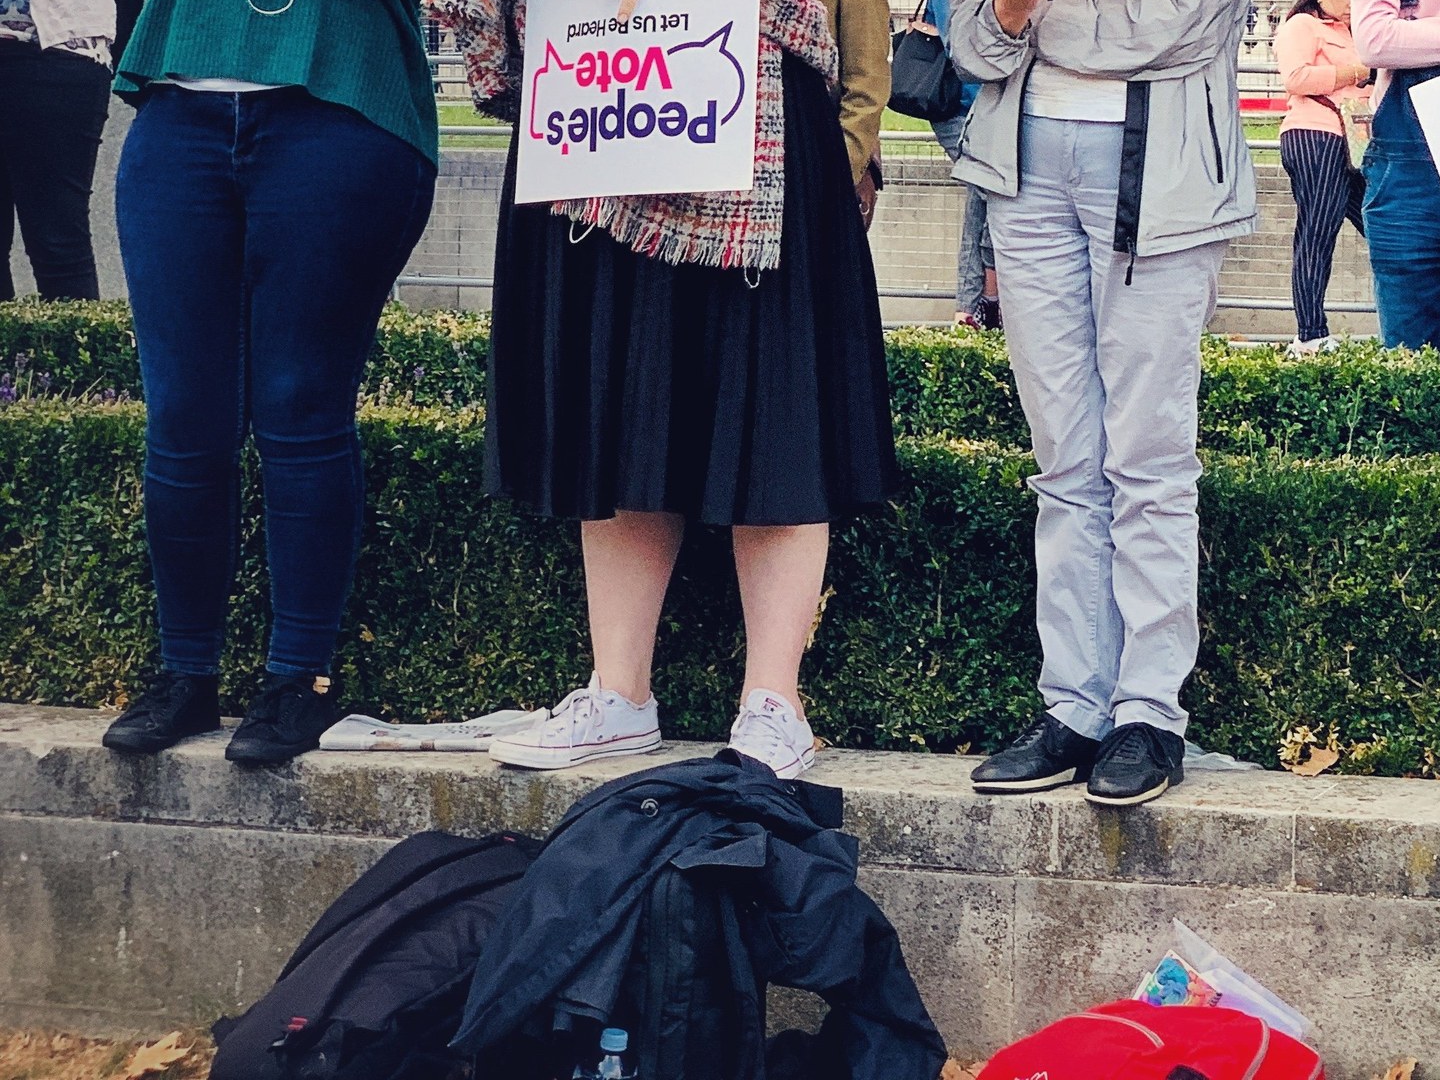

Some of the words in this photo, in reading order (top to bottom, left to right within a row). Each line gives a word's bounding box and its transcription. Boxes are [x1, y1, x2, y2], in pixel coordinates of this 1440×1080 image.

[567, 18, 607, 42] Heard
[633, 14, 656, 33] Us
[661, 13, 689, 31] Let
[575, 47, 673, 93] Vote
[547, 88, 717, 155] People's
